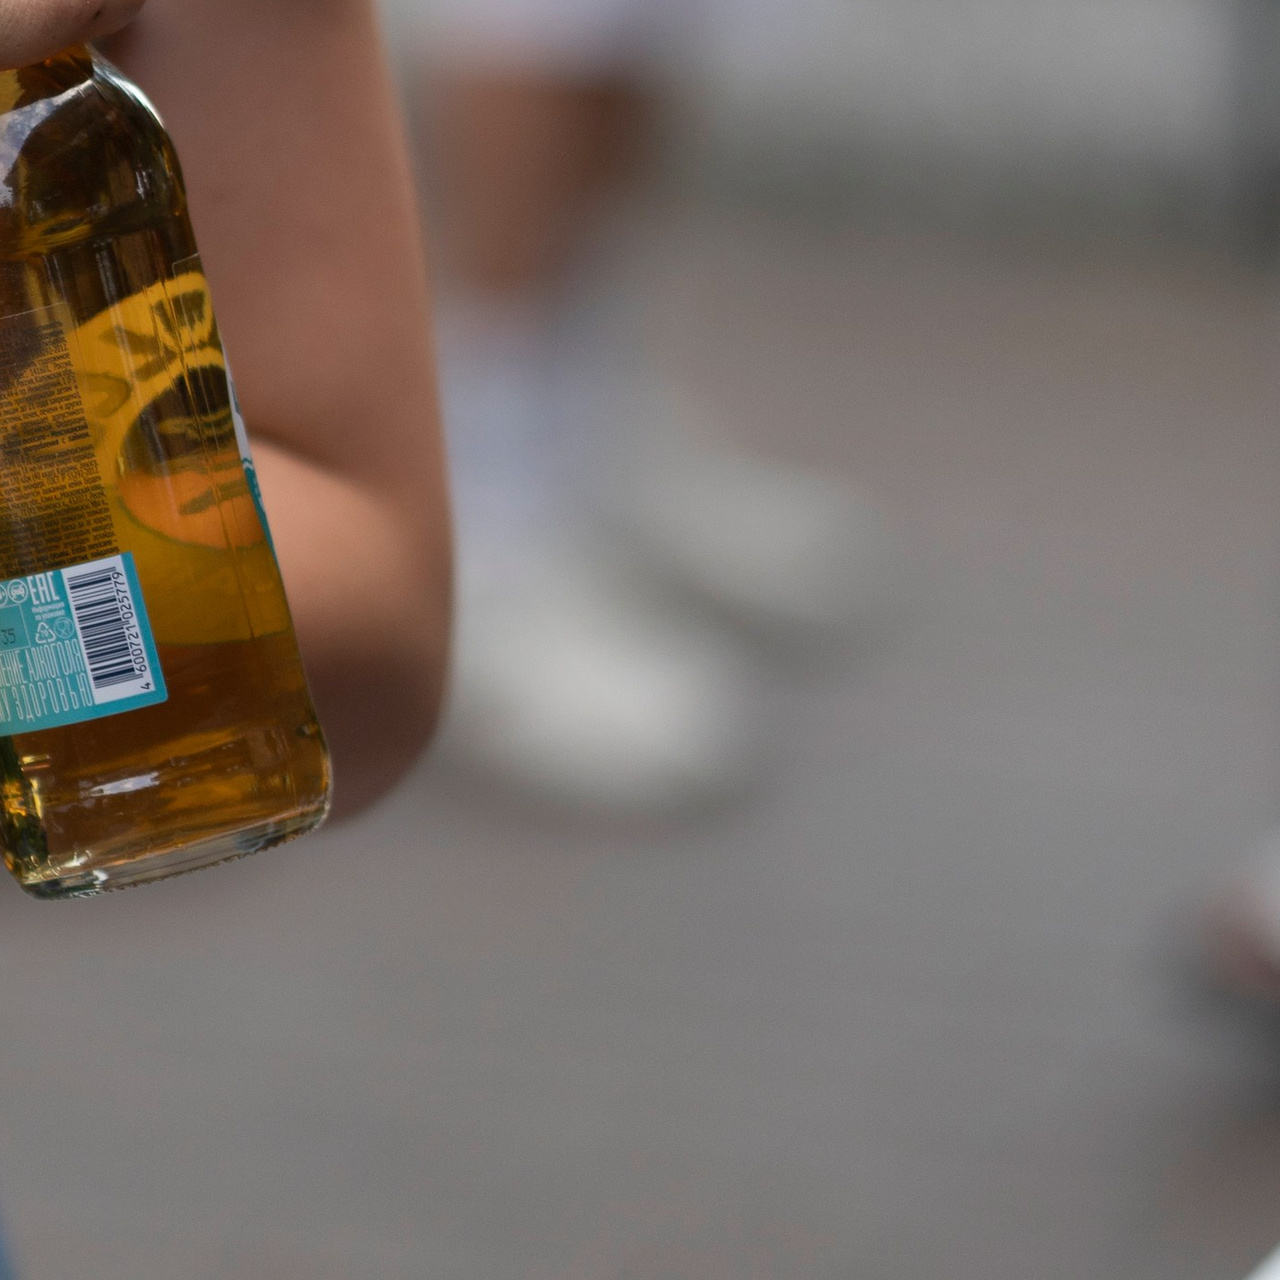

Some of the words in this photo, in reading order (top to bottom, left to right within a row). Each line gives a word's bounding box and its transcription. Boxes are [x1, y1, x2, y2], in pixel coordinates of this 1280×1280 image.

[111, 570, 134, 621] 025779
[24, 638, 85, 683] АЛКОГОЛЯ
[125, 624, 148, 675] 600721
[11, 671, 94, 724] ЗДОРОВЬЮ
[139, 681, 152, 692] 4
